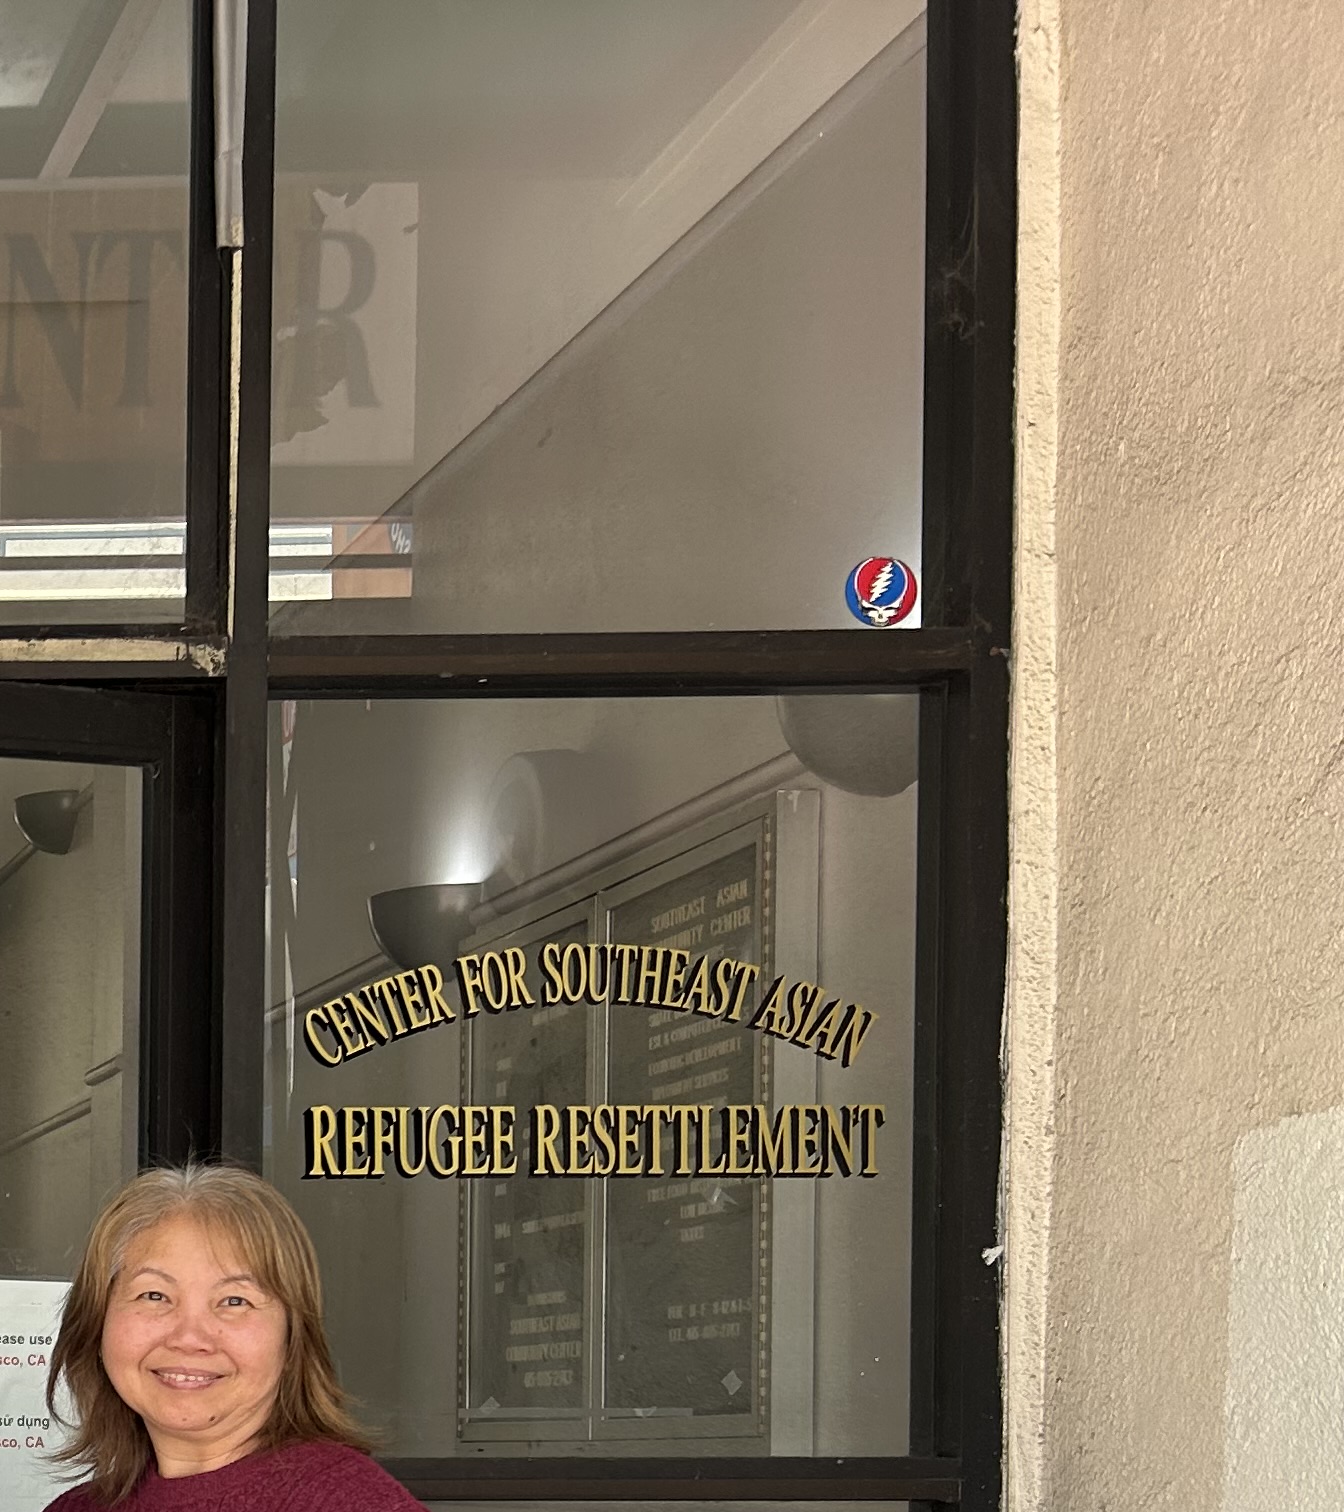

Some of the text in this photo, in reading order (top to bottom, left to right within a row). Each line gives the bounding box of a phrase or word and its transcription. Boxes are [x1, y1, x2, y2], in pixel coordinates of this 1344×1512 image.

[303, 942, 880, 1068] CENTER FOR SOUTHEAST ASIAN
[302, 1104, 887, 1179] REFUGEE RESETTLEMENT
[29, 1336, 53, 1346] use
[27, 1354, 46, 1366] CA
[17, 1415, 50, 1430] dụng
[25, 1436, 45, 1449] CA
